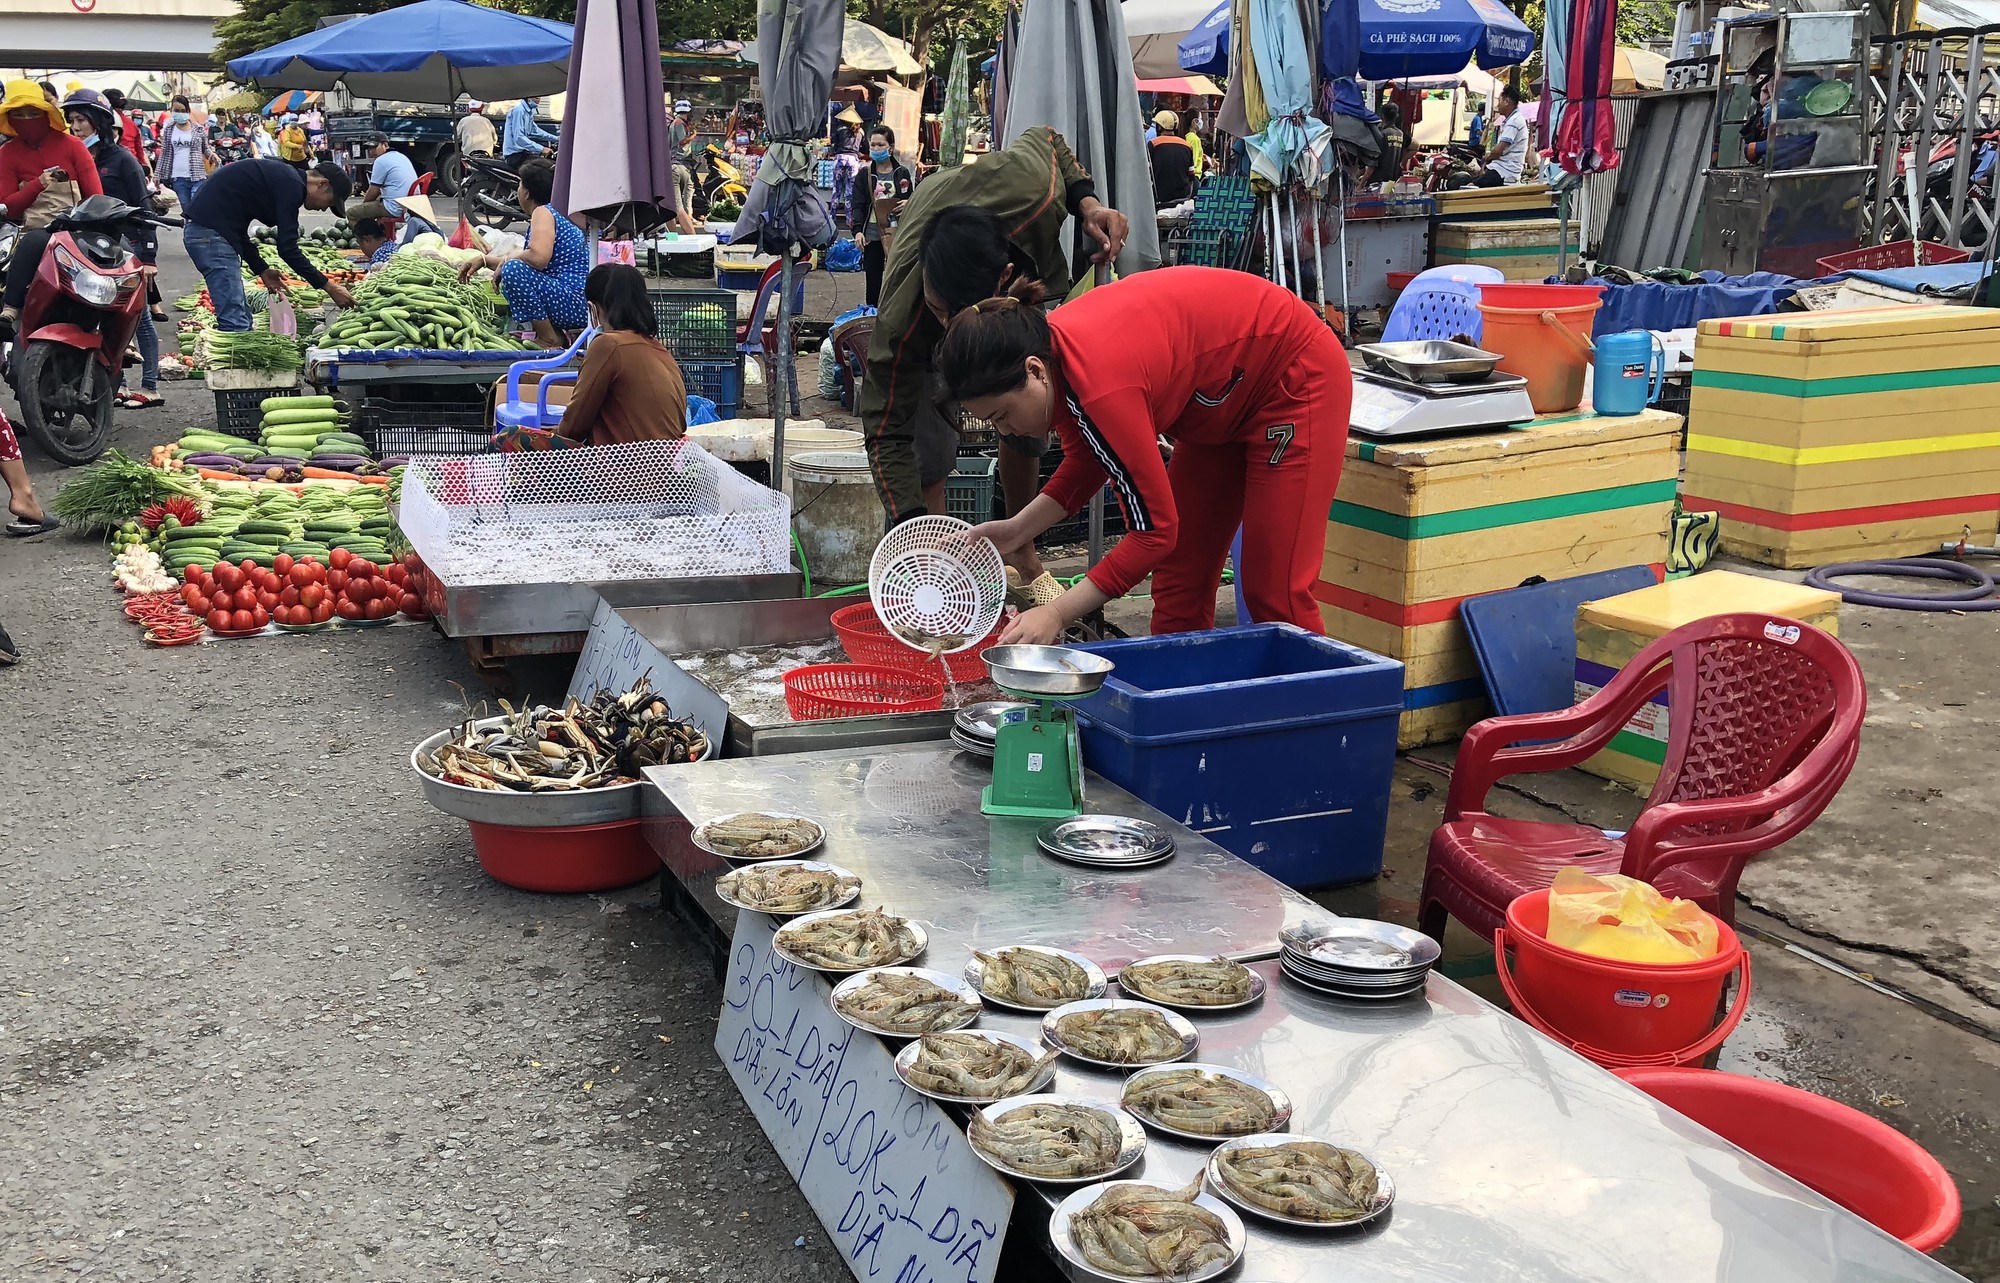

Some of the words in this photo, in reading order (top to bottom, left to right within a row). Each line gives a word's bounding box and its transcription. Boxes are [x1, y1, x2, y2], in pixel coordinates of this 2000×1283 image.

[1370, 32, 1383, 43] CÀ
[1386, 32, 1407, 43] PHÊ
[1409, 33, 1436, 45] SẠCH
[1439, 34, 1461, 43] 100%
[1266, 423, 1295, 465] 7
